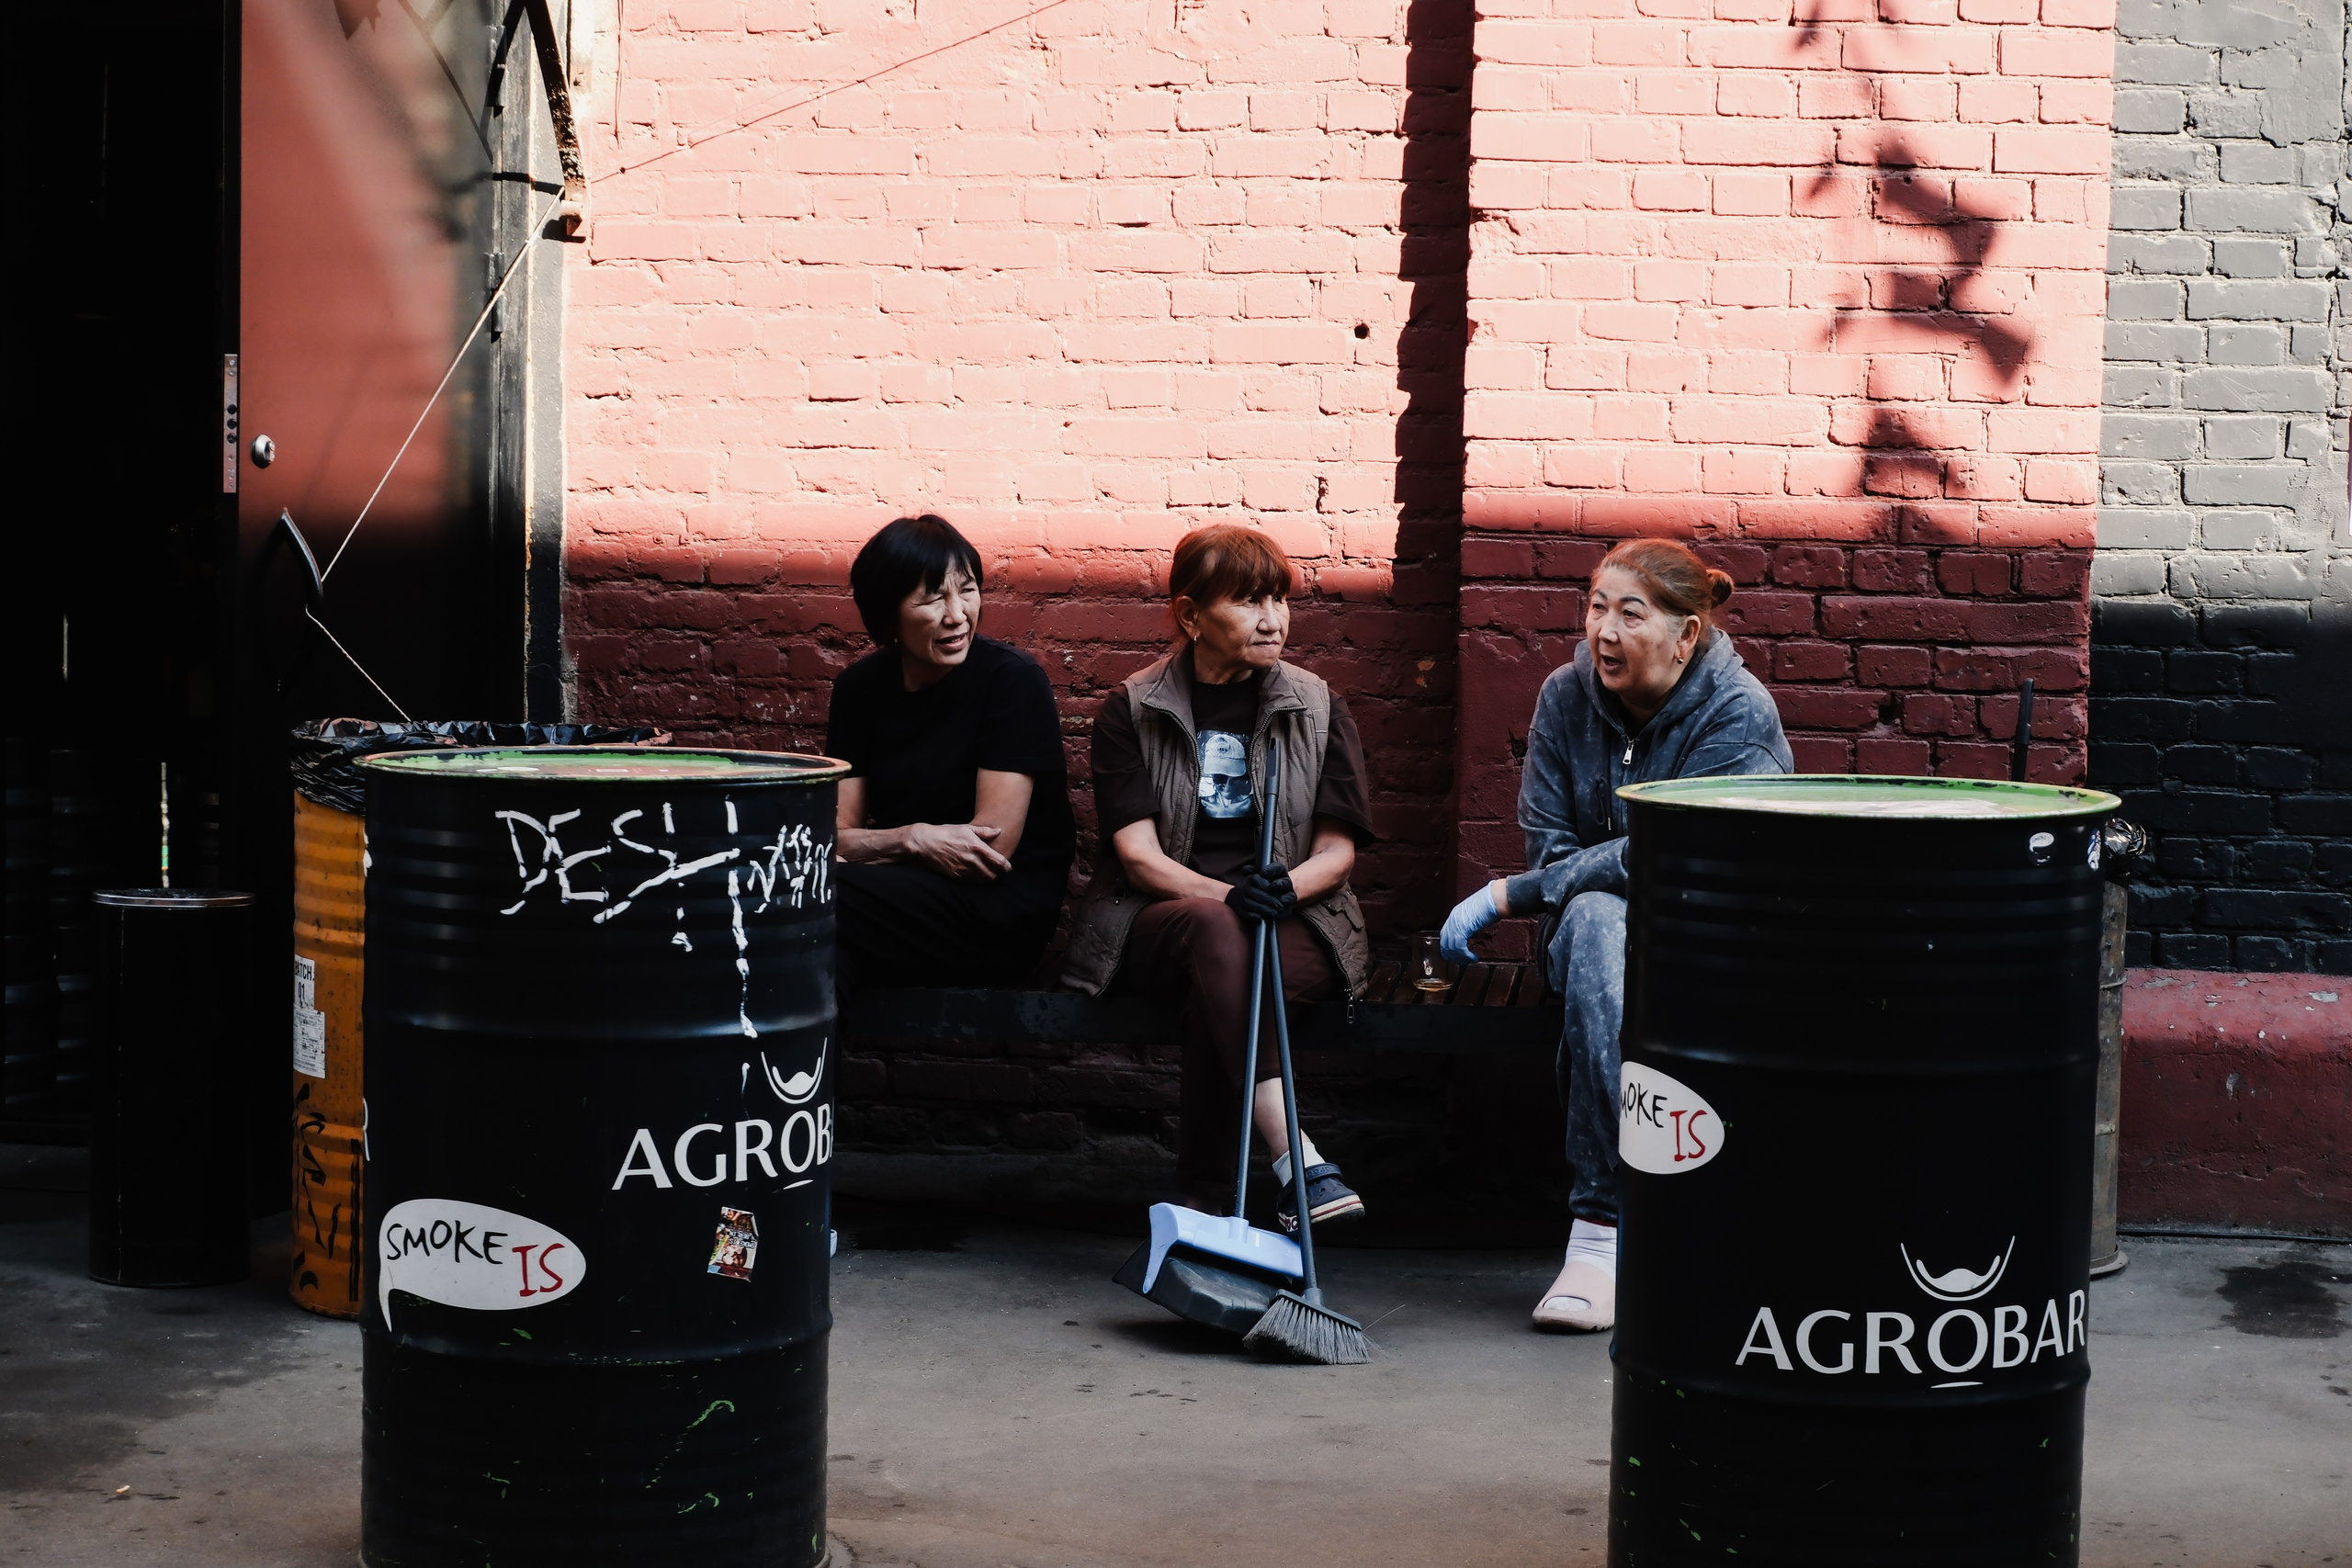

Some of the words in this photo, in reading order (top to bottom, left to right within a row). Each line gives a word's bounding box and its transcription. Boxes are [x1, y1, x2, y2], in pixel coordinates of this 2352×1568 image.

[610, 1098, 834, 1190] AGROB
[1621, 1082, 1668, 1128] MOKE
[1669, 1109, 1708, 1162] IS
[387, 1219, 509, 1265] SMOKE
[512, 1243, 566, 1297] IS
[1735, 1289, 2086, 1376] AGROBAR
